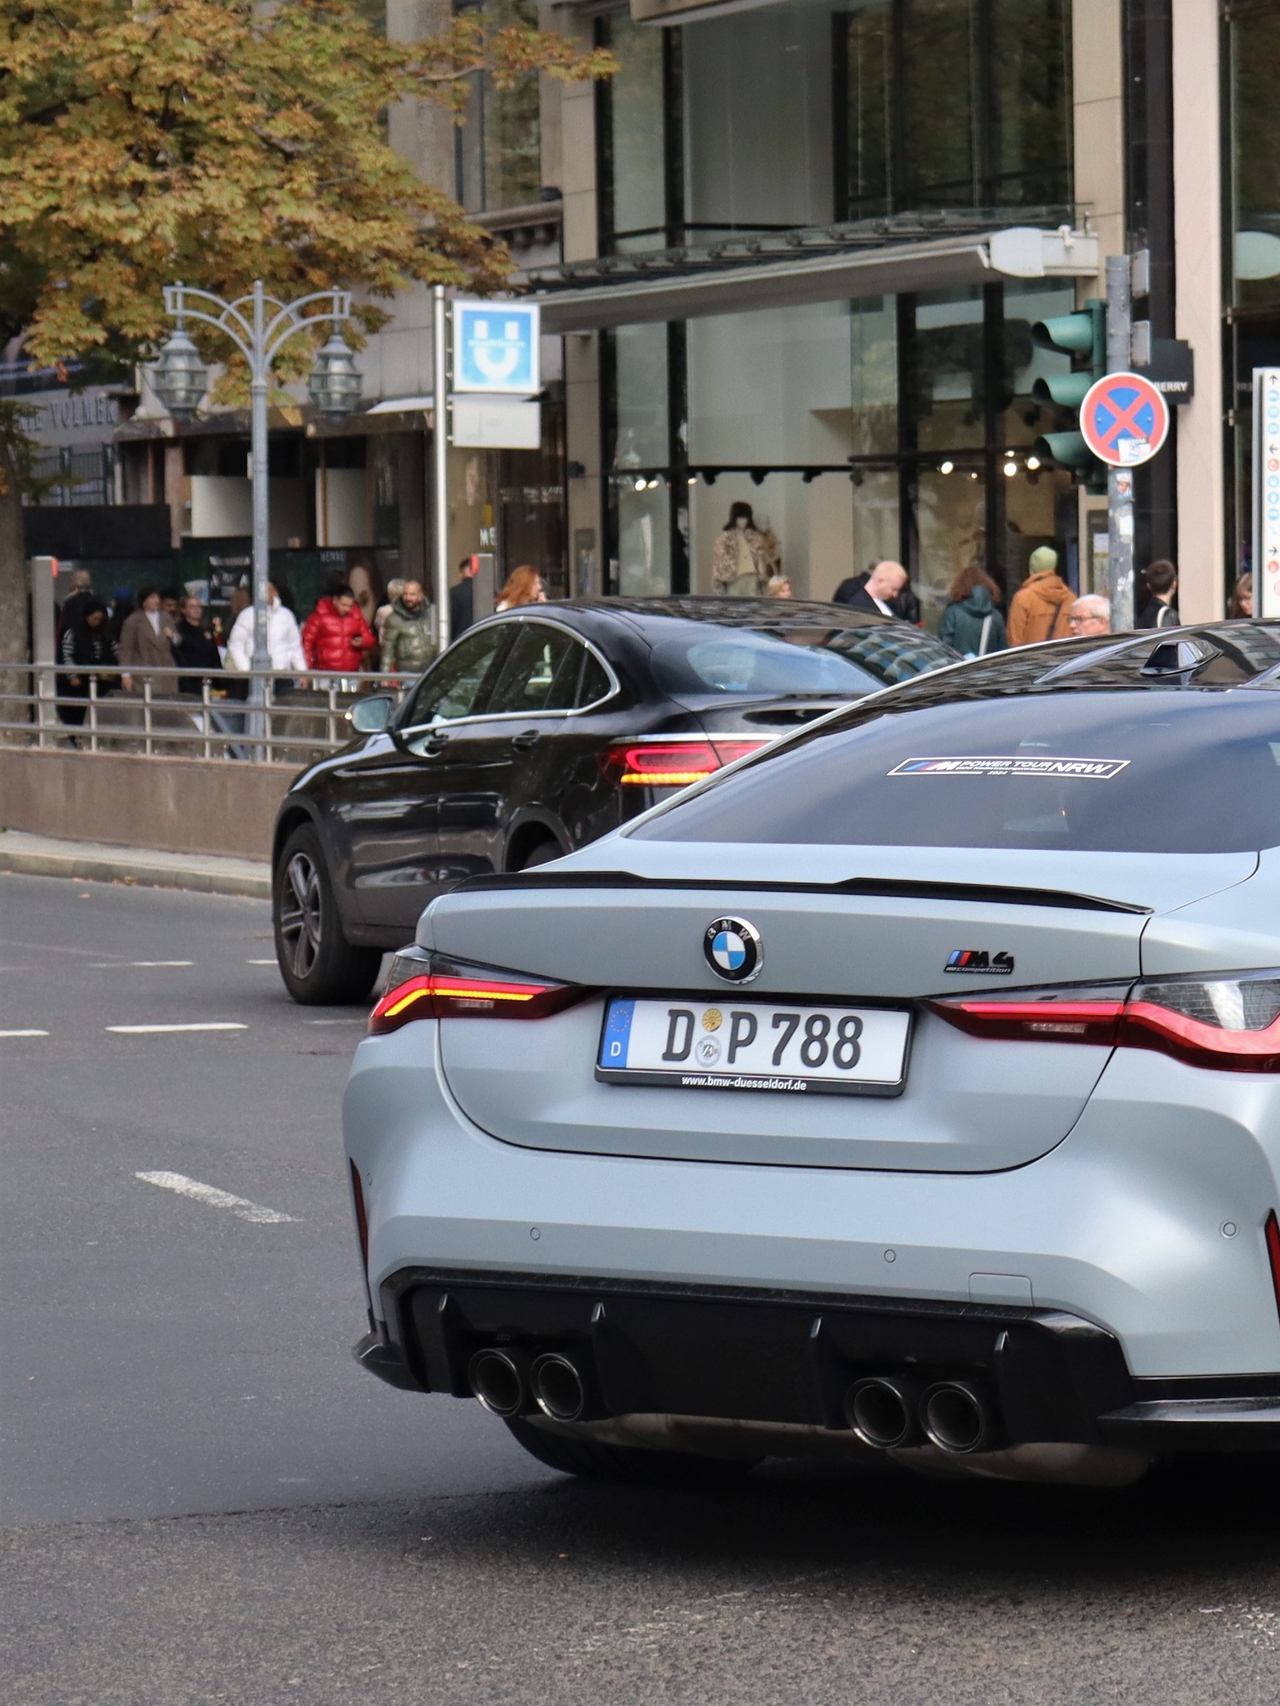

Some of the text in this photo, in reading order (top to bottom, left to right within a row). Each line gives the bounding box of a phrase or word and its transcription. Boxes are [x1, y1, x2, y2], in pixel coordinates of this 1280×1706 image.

[1154, 381, 1189, 393] BERRY
[960, 760, 1012, 768] POWER
[1013, 760, 1053, 769] TOUR
[1048, 762, 1113, 774] NRW
[706, 920, 752, 941] BMW
[661, 1008, 864, 1070] D P 788
[610, 1041, 622, 1057] D
[681, 1074, 807, 1091] www.bmw-duesseldorf.de
